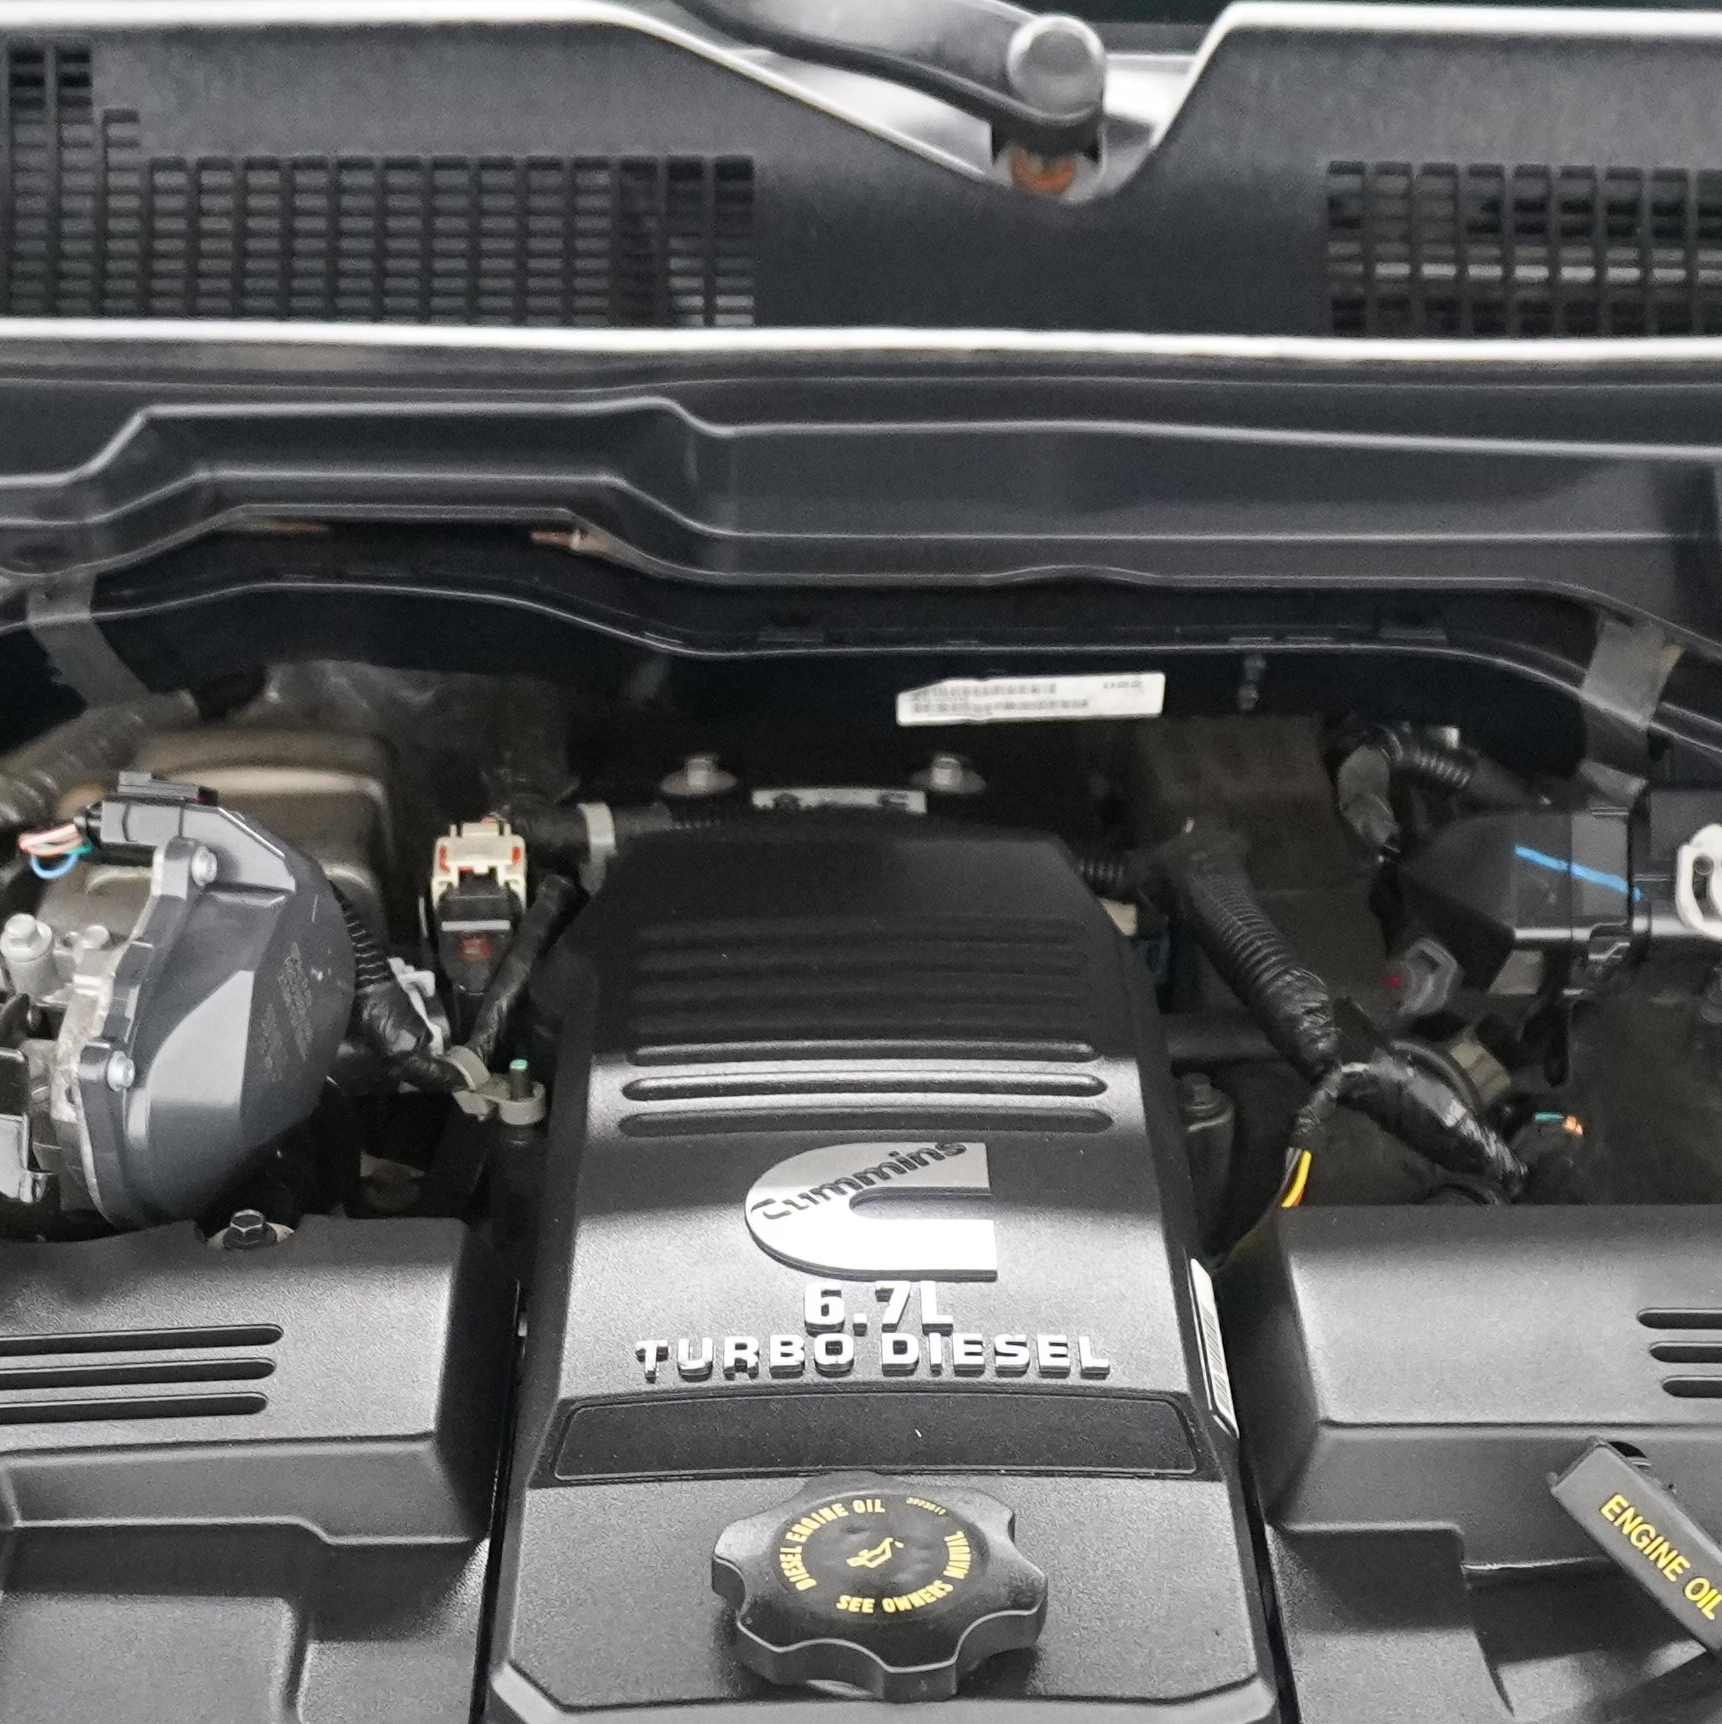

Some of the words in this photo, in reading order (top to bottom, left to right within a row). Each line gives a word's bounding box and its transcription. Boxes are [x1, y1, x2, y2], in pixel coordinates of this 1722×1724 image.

[750, 1141, 967, 1220] Cummins
[804, 1281, 954, 1335] 6.7L
[636, 1333, 855, 1381] TURBO
[881, 1333, 1111, 1380] DIESEL
[785, 1502, 849, 1543] ENGINE
[852, 1499, 885, 1513] OIL
[779, 1545, 817, 1591] DIESEL
[1600, 1493, 1691, 1582] ENGINE
[1684, 1577, 1722, 1621] OIL
[836, 1595, 875, 1614] SEE
[882, 1579, 953, 1614] OWNERS
